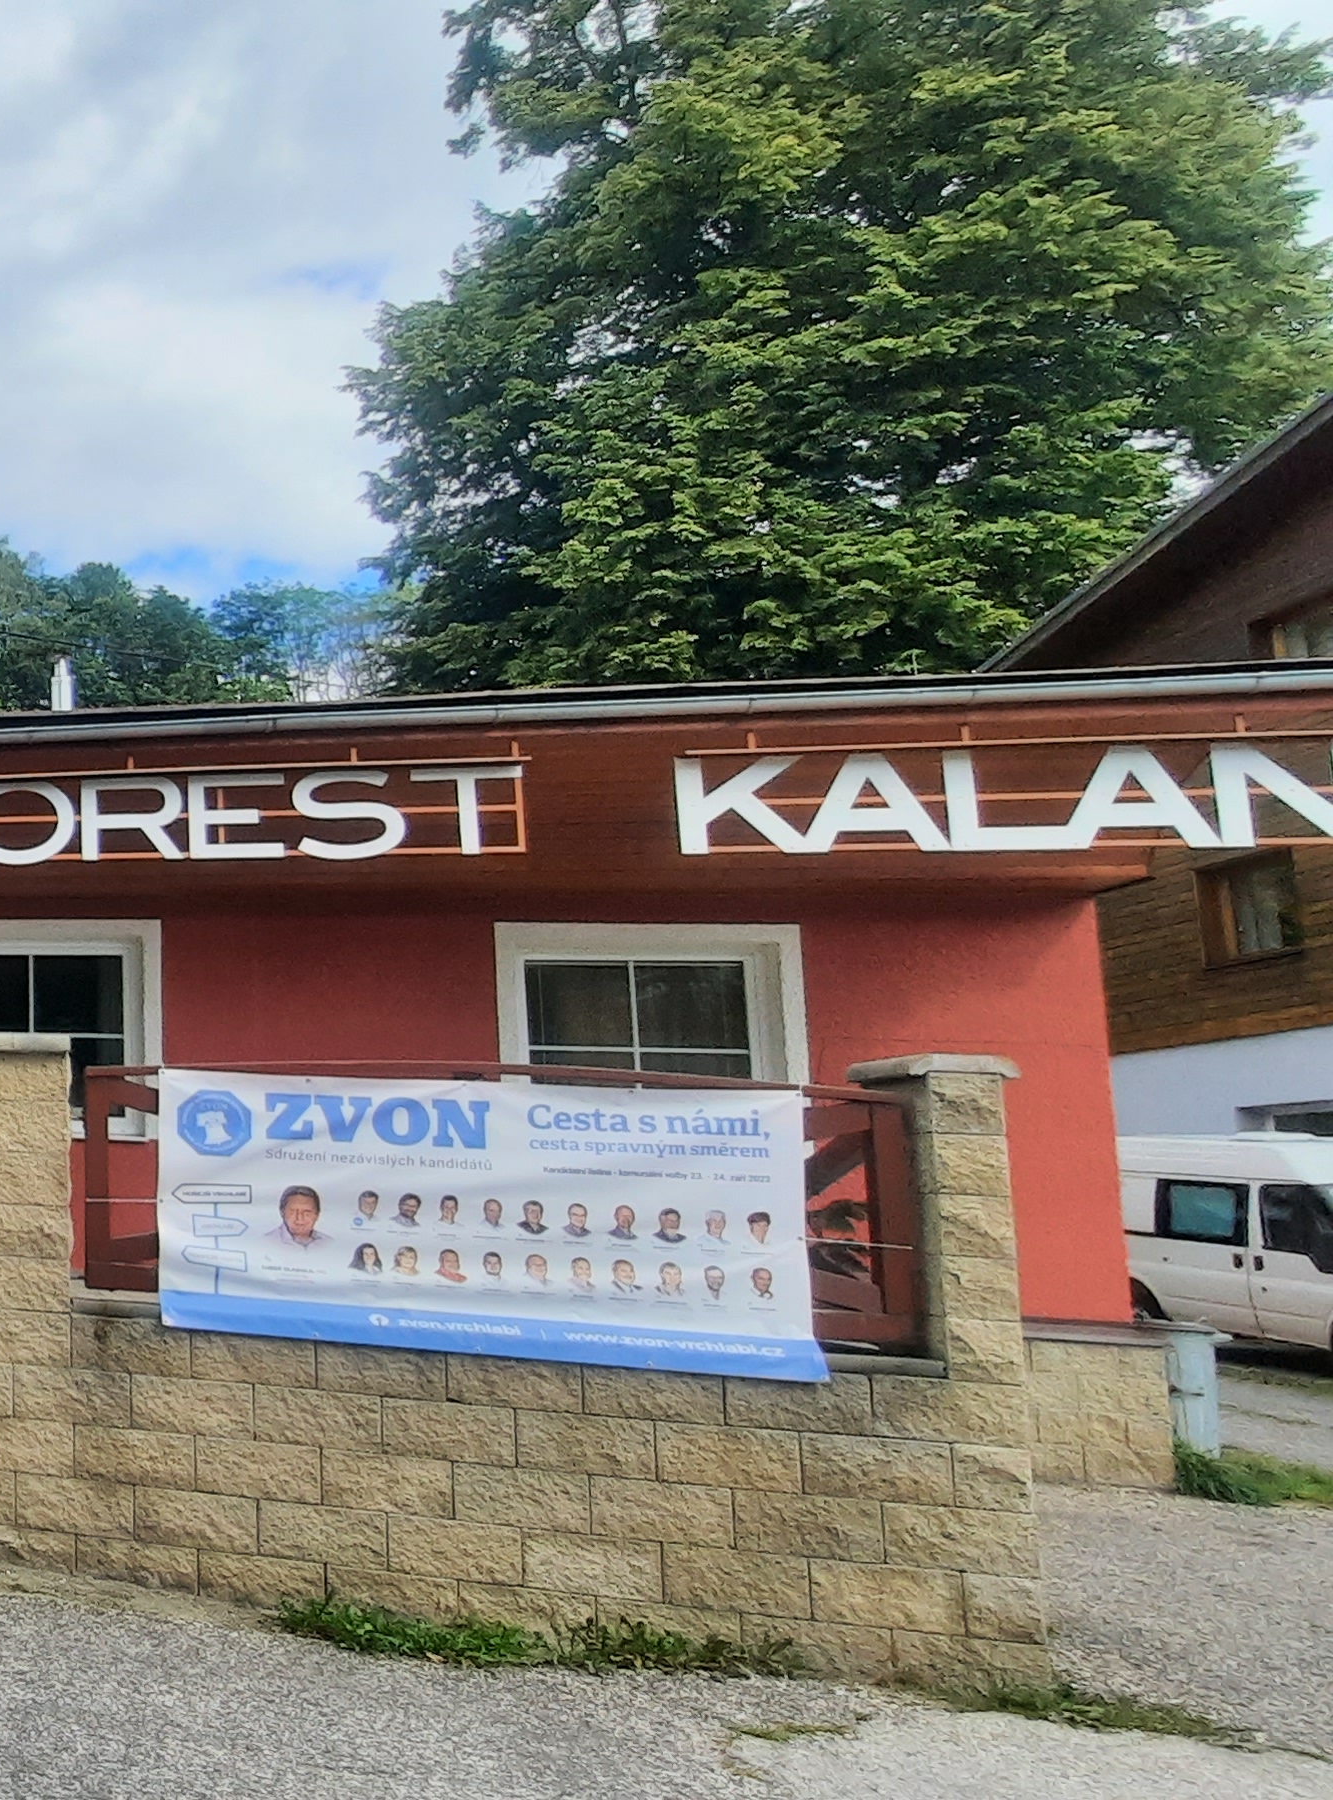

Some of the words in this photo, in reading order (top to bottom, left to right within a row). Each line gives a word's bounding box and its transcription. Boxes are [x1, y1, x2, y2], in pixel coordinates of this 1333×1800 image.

[673, 741, 1333, 855] KALAN
[264, 1092, 490, 1150] ZVON
[527, 1104, 631, 1133] Cesta
[638, 1114, 658, 1134] s
[664, 1108, 771, 1141] námi,
[265, 1147, 327, 1163] Sdružení
[331, 1151, 415, 1169] nezávislých
[419, 1156, 493, 1171] kandidátů
[529, 1137, 580, 1152] cesta
[690, 1142, 770, 1158] směrem
